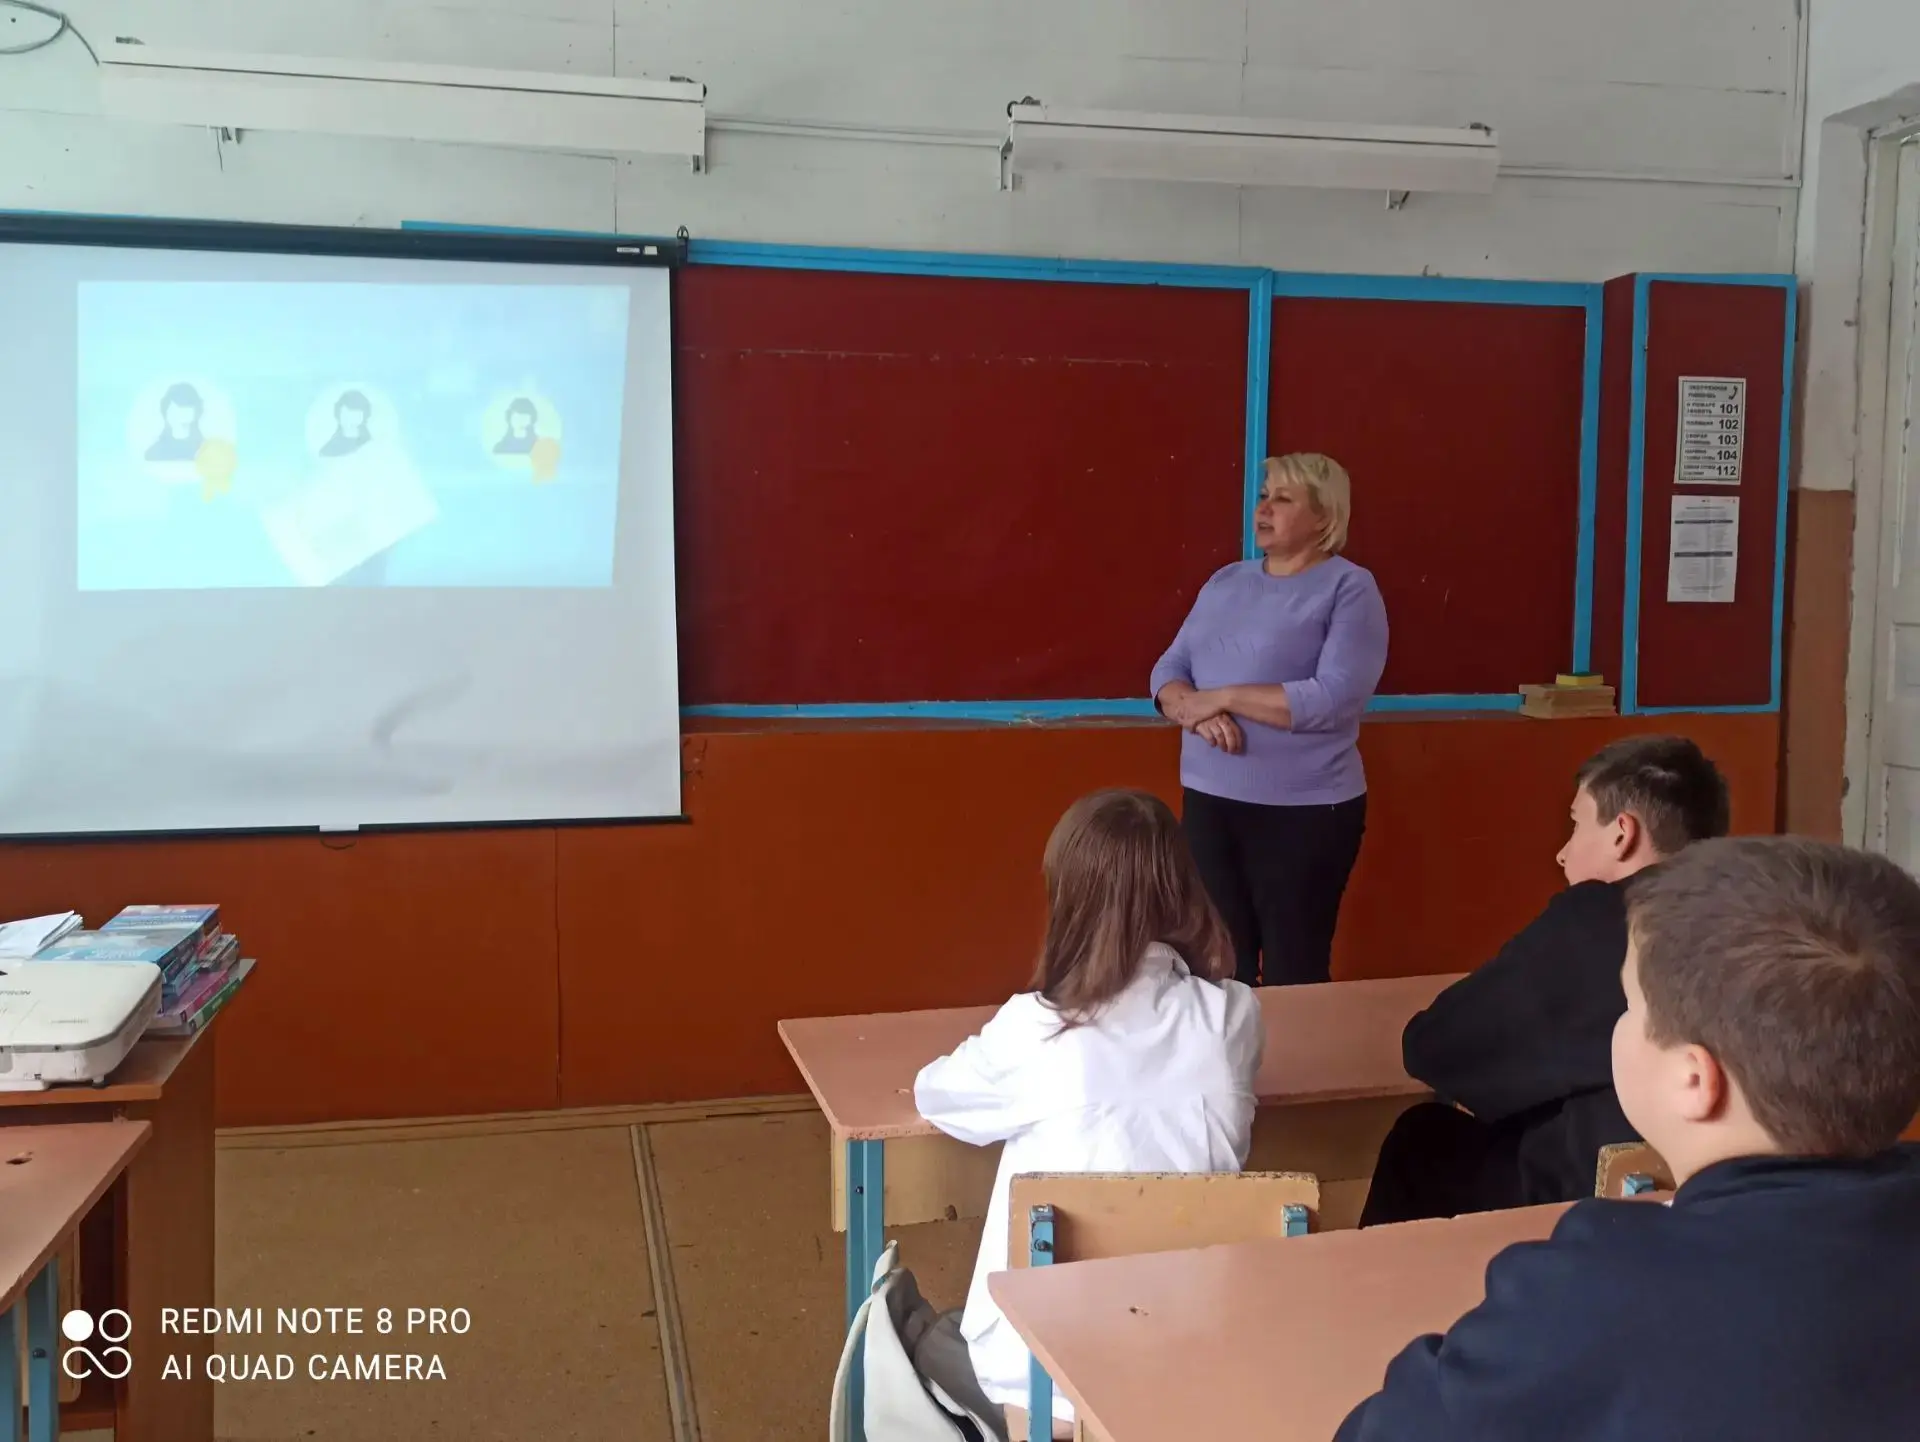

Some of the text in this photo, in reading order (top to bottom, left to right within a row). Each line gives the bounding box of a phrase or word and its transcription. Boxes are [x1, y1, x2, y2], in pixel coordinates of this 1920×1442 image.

[1720, 403, 1739, 414] 101
[1719, 419, 1739, 430] 102
[1718, 434, 1738, 445] 103
[1717, 450, 1737, 461] 104
[1716, 465, 1737, 476] 112
